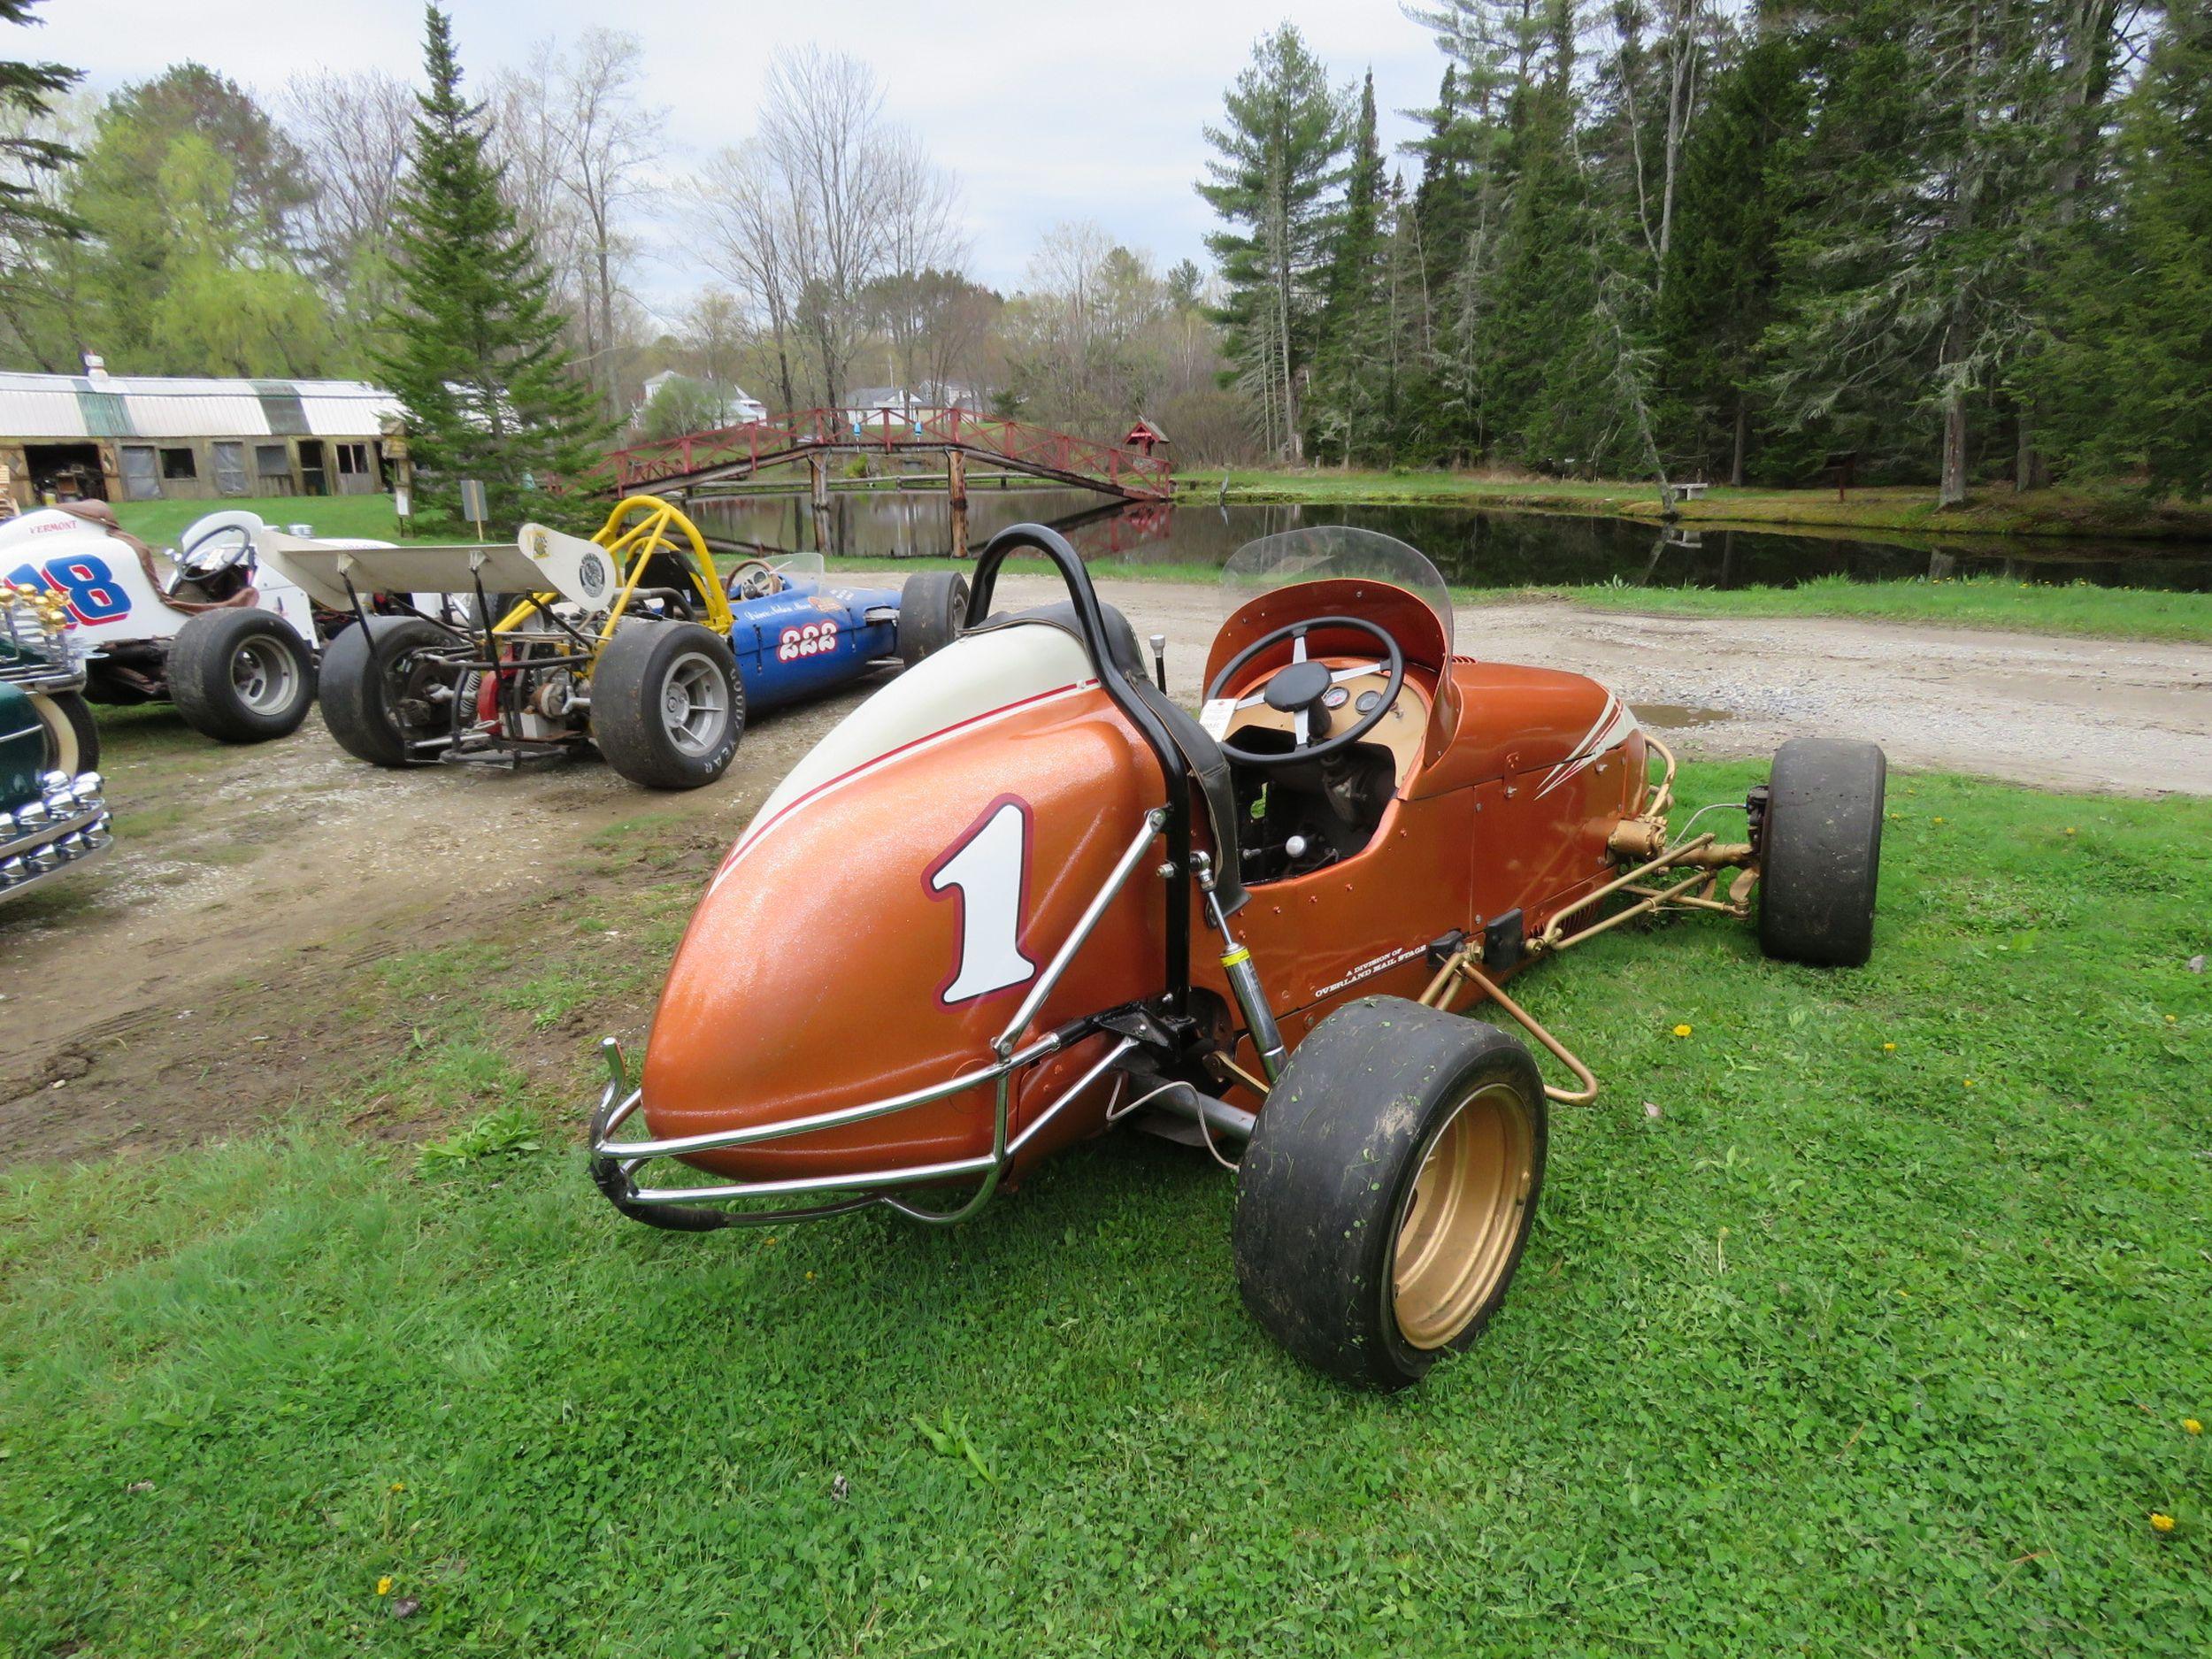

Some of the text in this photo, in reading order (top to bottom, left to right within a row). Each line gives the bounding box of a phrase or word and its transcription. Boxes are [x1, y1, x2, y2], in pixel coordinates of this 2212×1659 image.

[28, 519, 78, 534] VERMONT
[4, 553, 132, 630] 18
[779, 620, 838, 662] 222
[922, 794, 1045, 1014] 1
[1315, 944, 1426, 997] OVERLAND MAIL STAGE
[1354, 952, 1391, 973] DIVISION
[1392, 948, 1402, 956] OF
